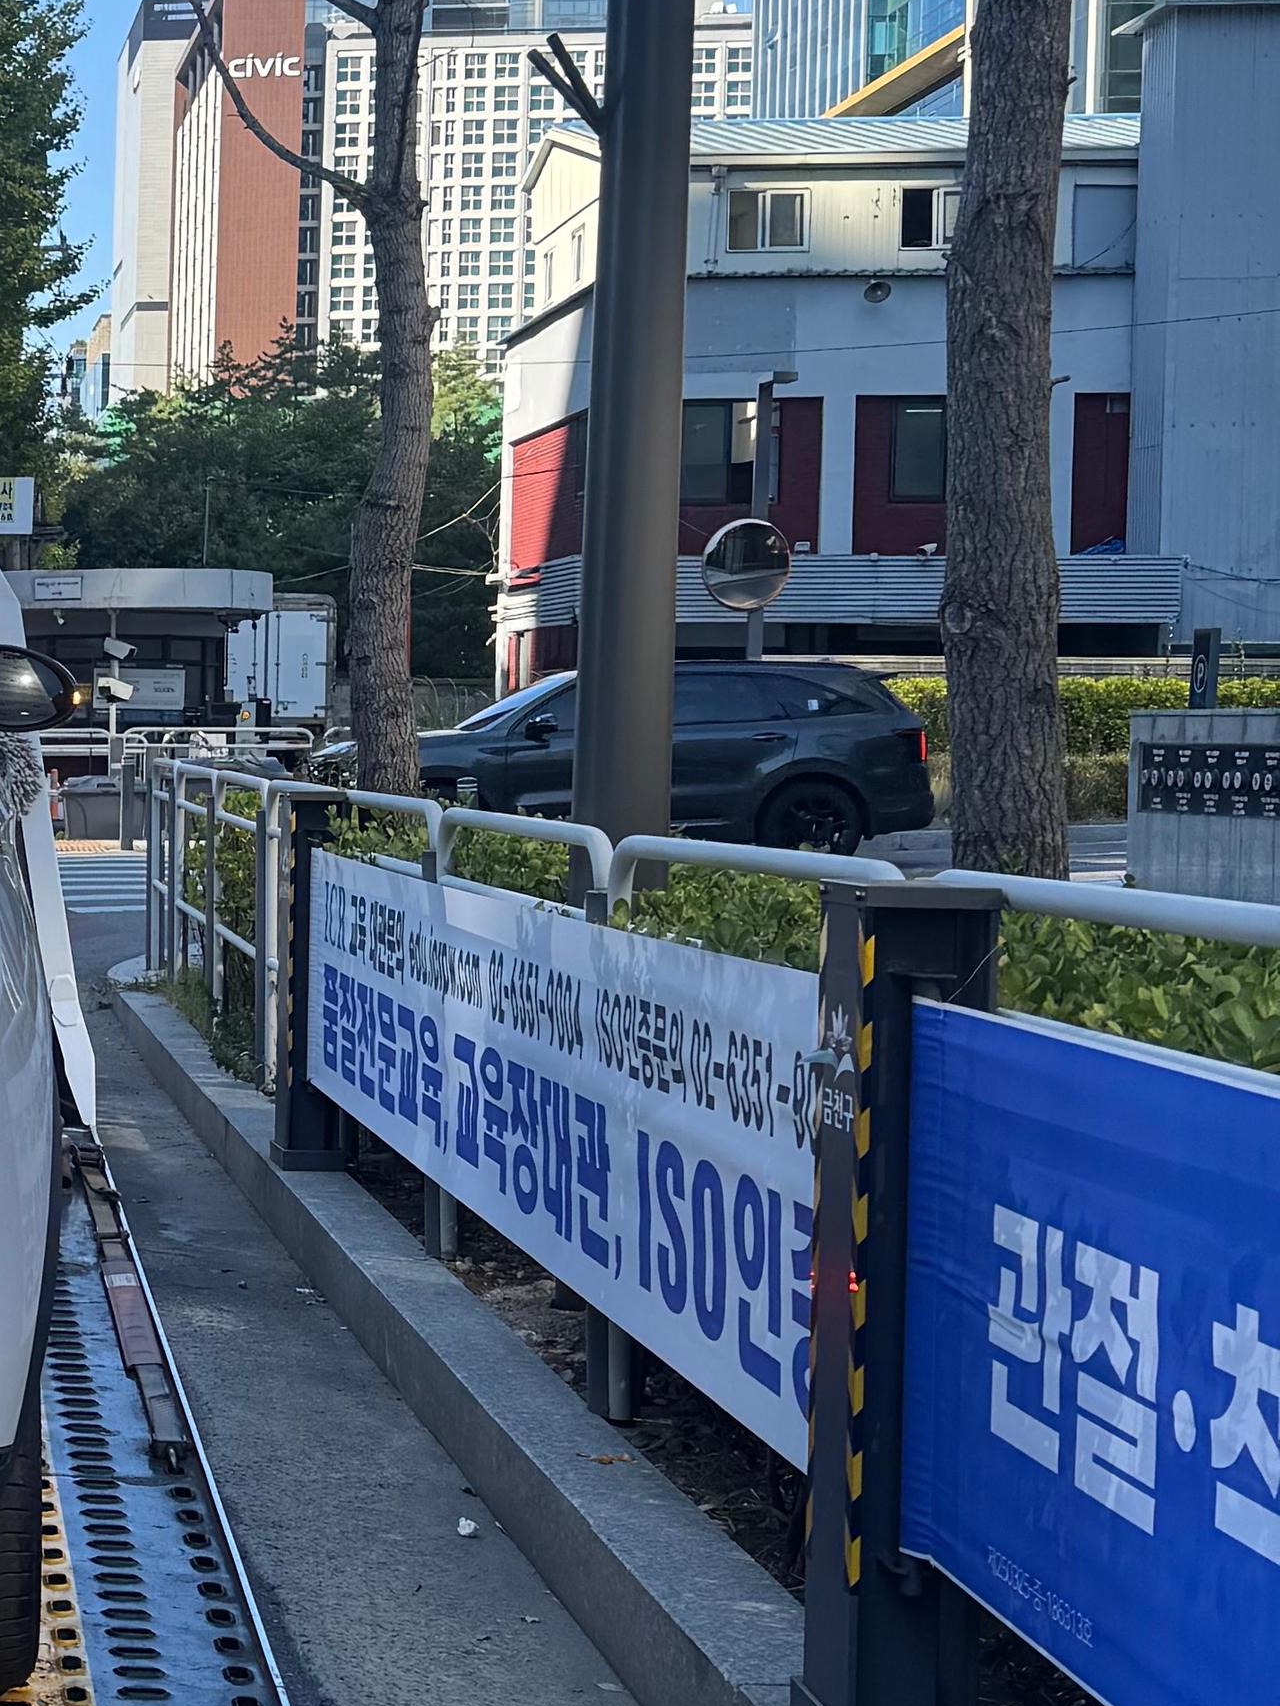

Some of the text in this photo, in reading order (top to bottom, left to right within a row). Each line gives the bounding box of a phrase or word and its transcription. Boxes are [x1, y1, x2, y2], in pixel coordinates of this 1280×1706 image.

[324, 881, 346, 953] ICR
[349, 894, 367, 966] 교육
[489, 949, 584, 1061] 02-6351-9004
[595, 988, 687, 1104] ISO인증문의
[323, 963, 448, 1155] 품질전문교육,
[453, 1033, 622, 1281] 교육장대관,
[823, 1087, 855, 1132] 금천구
